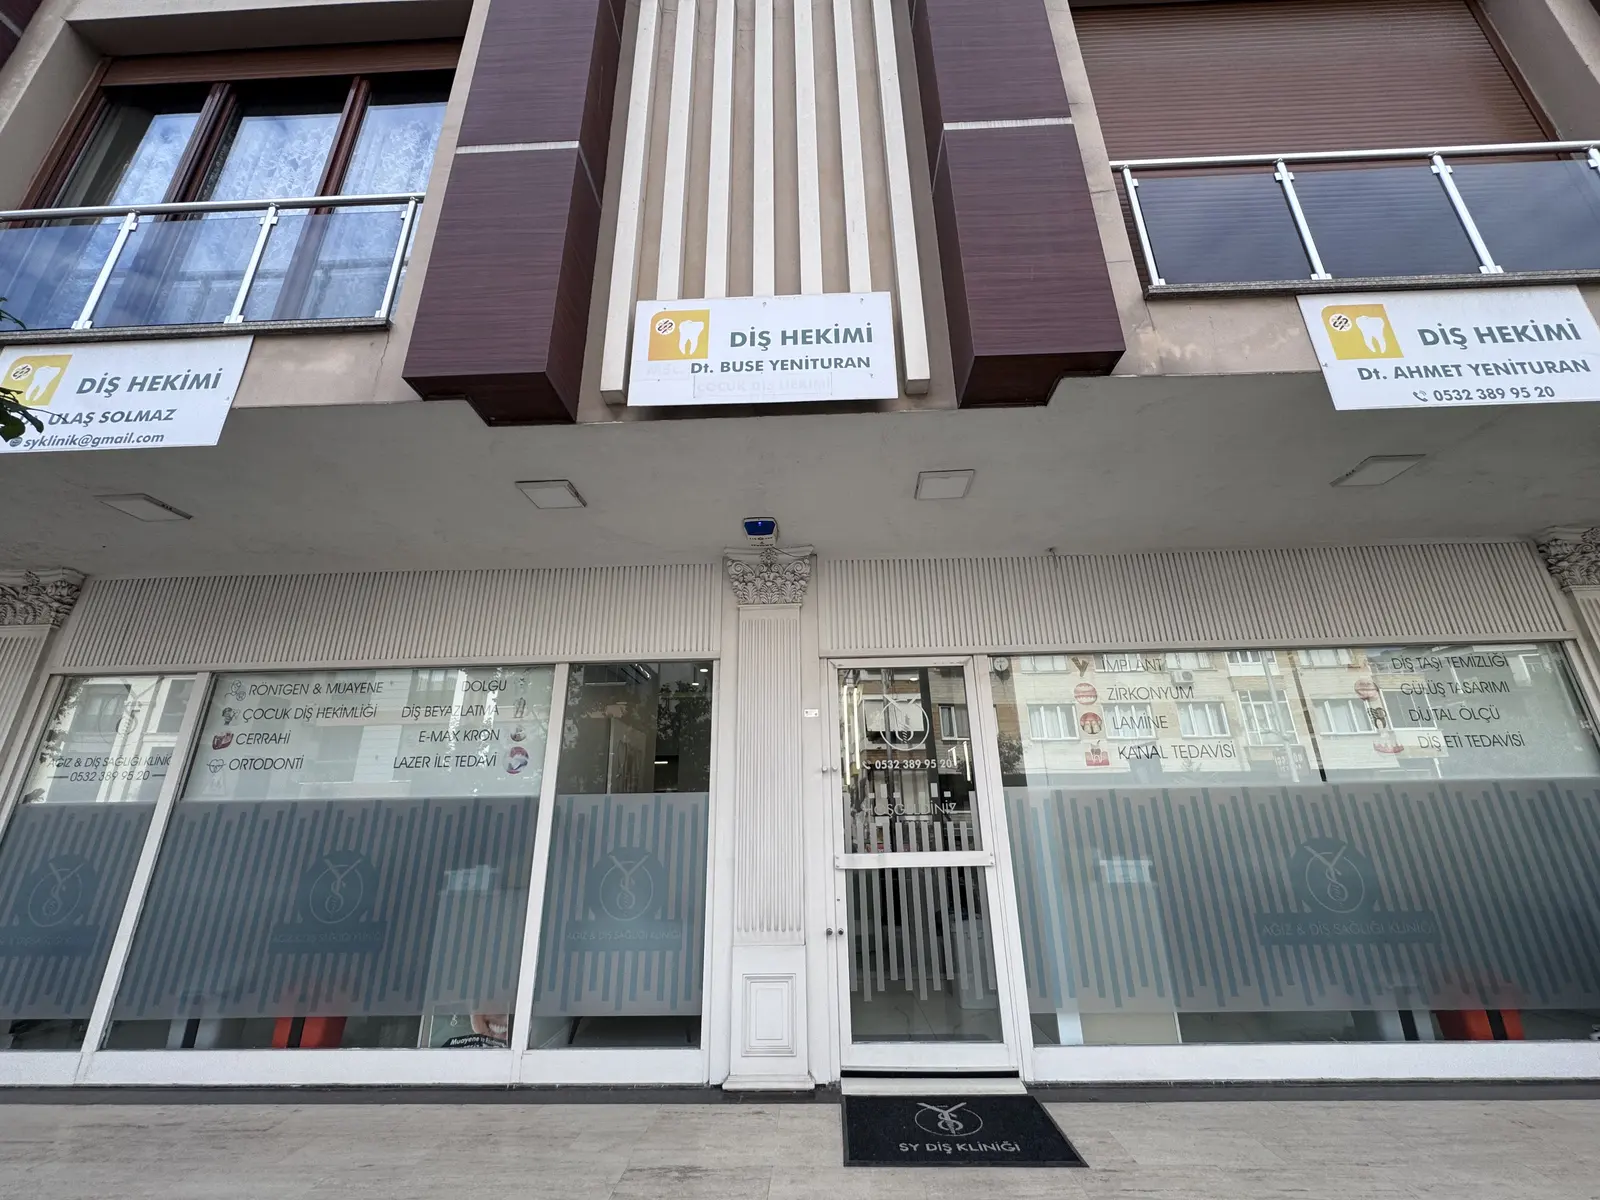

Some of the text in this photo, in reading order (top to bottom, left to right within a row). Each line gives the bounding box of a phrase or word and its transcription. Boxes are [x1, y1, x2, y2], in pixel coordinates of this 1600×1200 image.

[730, 322, 873, 352] DİŞ HEKİMİ
[1416, 318, 1582, 350] DİŞ HEKİMİ
[690, 363, 714, 374] Dt.
[720, 359, 764, 373] BUSE
[770, 356, 871, 371] YENİTURAN
[1357, 358, 1592, 381] Dt. AHMET YENİTURAN
[76, 368, 223, 398] DİŞ HEKİMİ
[1433, 386, 1555, 401] 0532 389 95 20
[48, 411, 95, 427] ULAŞ
[98, 408, 177, 424] SOLMAZ
[23, 433, 164, 450] syklinik@gmail.com
[1102, 655, 1163, 672] İMPLANT
[1392, 652, 1509, 673] DİŞ TAŞI TEMİZLİĞİ
[249, 682, 384, 696] RÖNTGEN & MUAYENE
[461, 680, 507, 692] DOLGU
[1107, 685, 1194, 701] ZİRKONYUM
[1400, 680, 1510, 697] GÜLÜŞ TASARIMI
[242, 704, 378, 723] ÇOCUK DİŞ HEKİMLİĞİ
[401, 703, 499, 720] DİŞ BEYAZLATMA
[1459, 705, 1501, 723] ÖLÇÜ
[1112, 713, 1169, 729] LAMİNE
[235, 730, 292, 745] CERRAHİ
[418, 729, 500, 742] E-MAX KRON
[1417, 731, 1526, 751] DİŞ ETİ TEDAVİSİ
[1118, 741, 1237, 759] KANAL TEDAVİSİ
[73, 758, 82, 767] &
[84, 755, 101, 769] DİŞ
[103, 754, 142, 767] SAĞLIĞI
[228, 755, 305, 770] ORTODONTİ
[393, 752, 498, 768] LAZER İLE TEDAVİ
[874, 758, 952, 769] 0532 389 95 20
[69, 770, 150, 782] 0532 389 95 20
[899, 1141, 1021, 1154] SY DİŞ KLİNİĞİ
